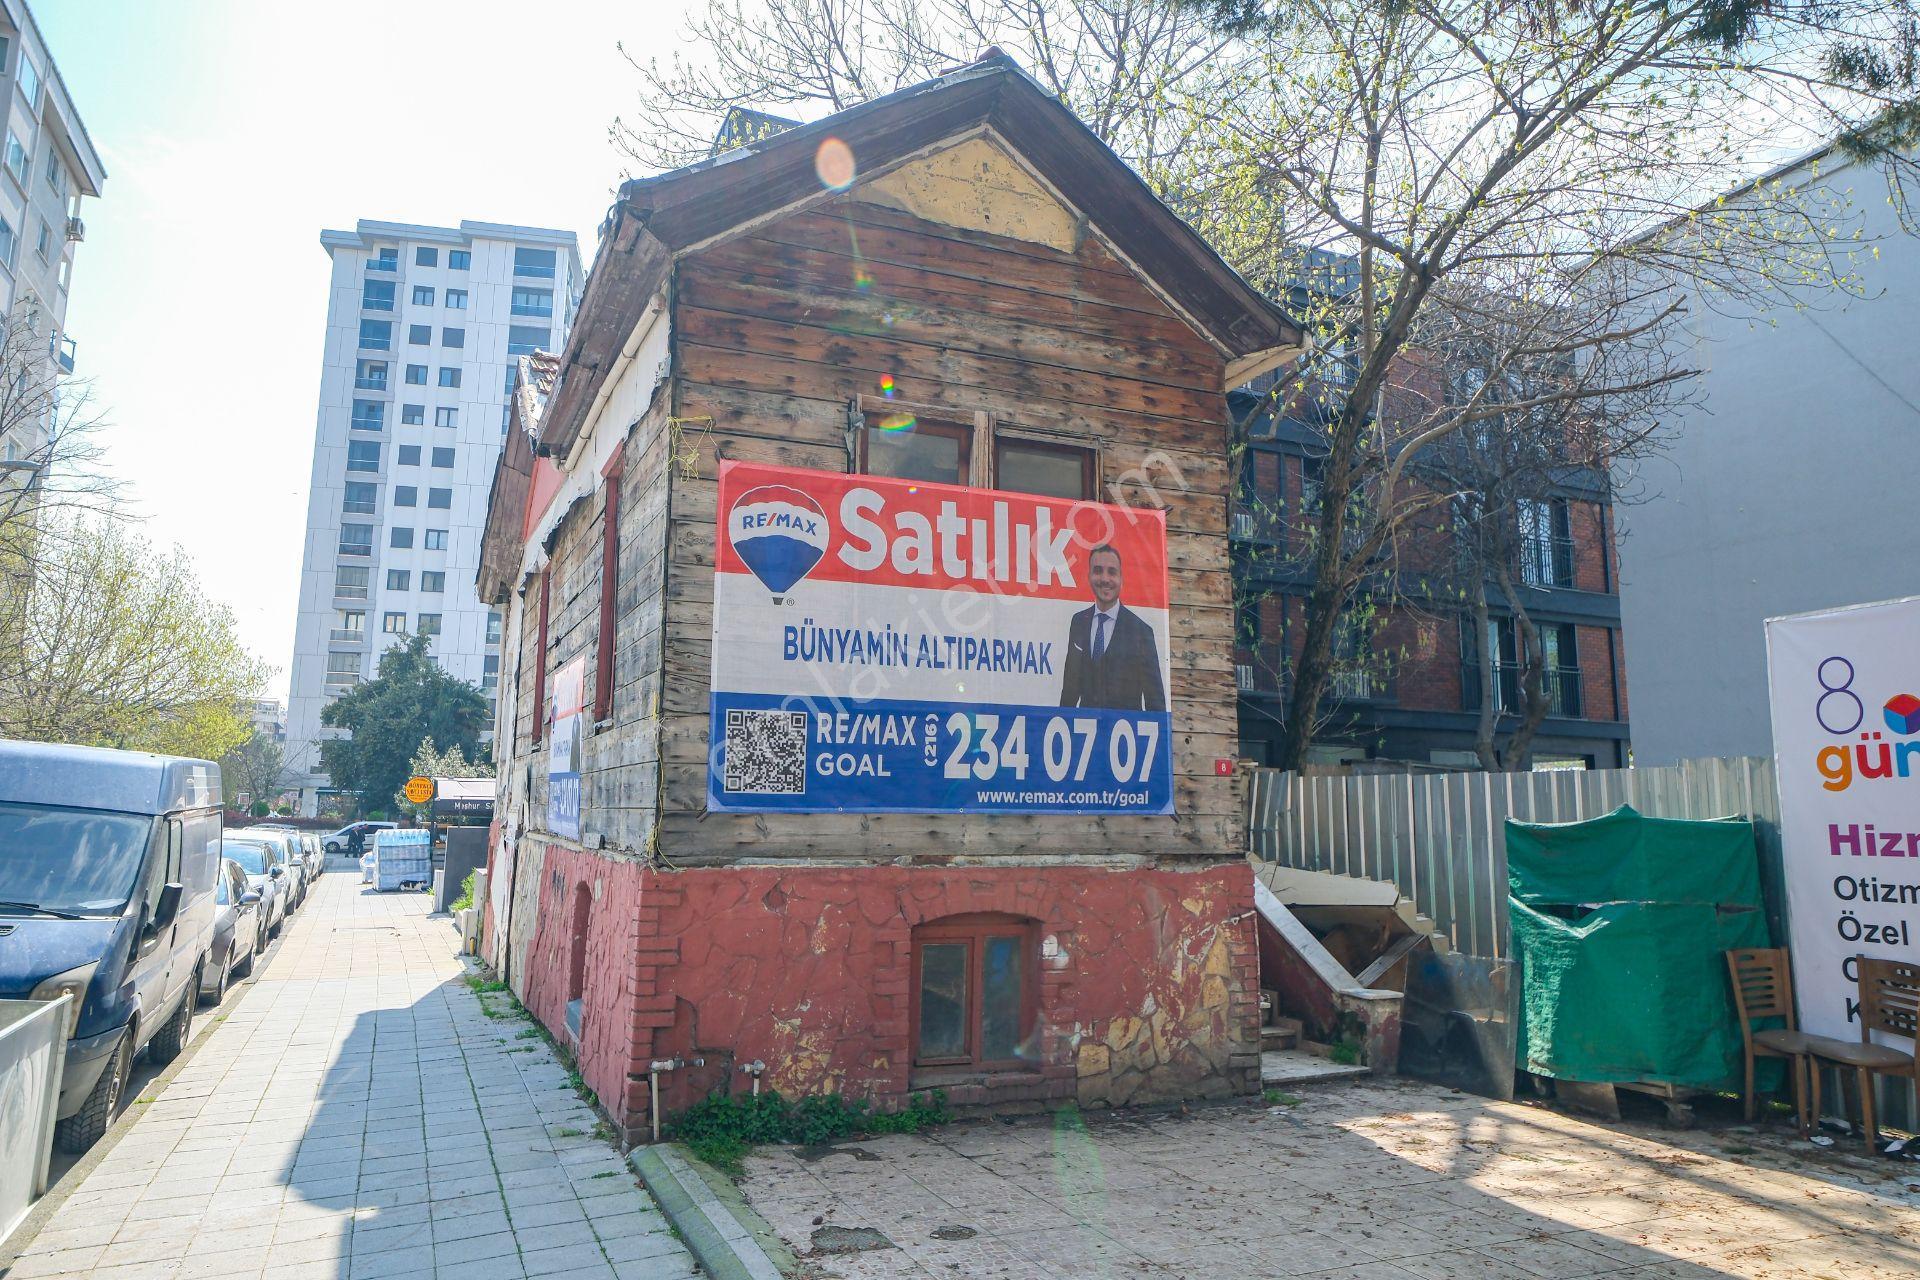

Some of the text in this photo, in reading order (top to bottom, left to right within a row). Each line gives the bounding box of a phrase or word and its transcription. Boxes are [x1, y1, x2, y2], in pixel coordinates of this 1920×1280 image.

[742, 512, 817, 537] RE/MAX
[837, 487, 1077, 588] Satılık
[783, 618, 1053, 676] BÜNYAMİN ALTIPARMAK
[815, 712, 917, 746] RE/MAX
[924, 713, 940, 767] (216)
[815, 753, 891, 777] GOAL
[944, 712, 1160, 783] 234 07 07
[1221, 762, 1227, 772] 8
[977, 789, 1149, 806] www.remax.com.tr/goal
[1837, 910, 1909, 946] Özel
